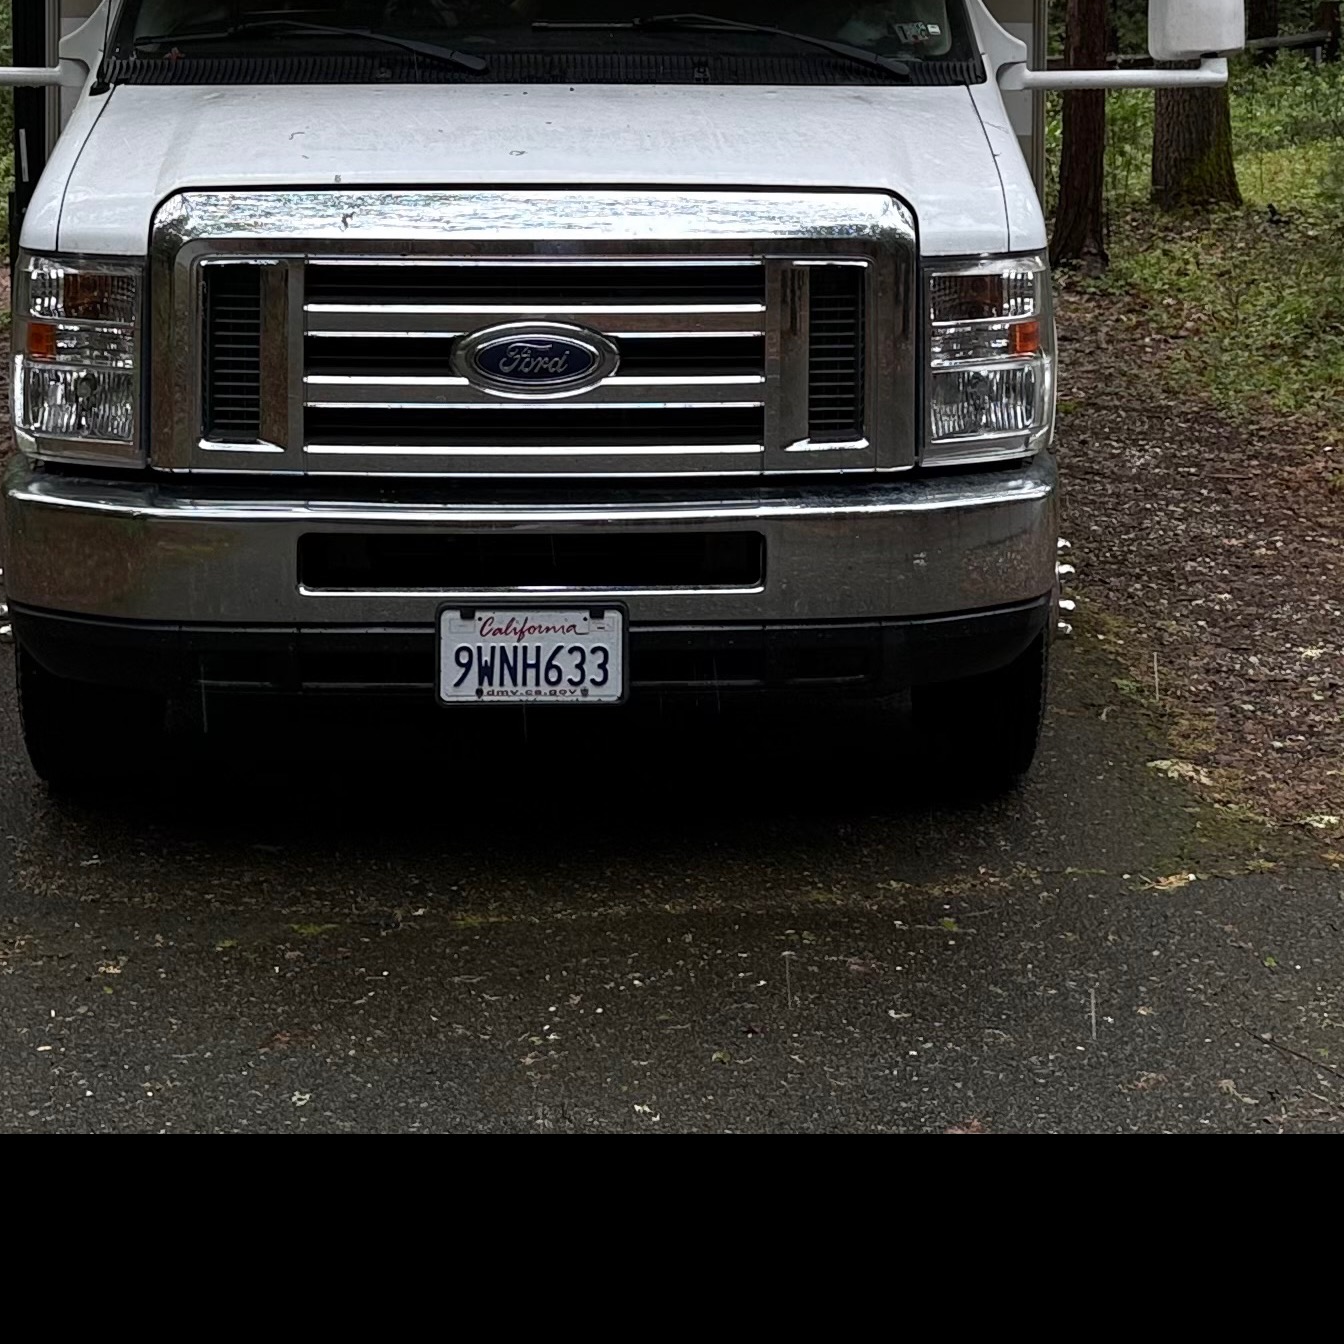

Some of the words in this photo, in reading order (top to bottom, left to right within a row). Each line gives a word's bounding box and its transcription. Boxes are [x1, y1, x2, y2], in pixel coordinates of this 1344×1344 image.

[498, 342, 571, 374] Ford
[479, 616, 590, 643] California
[453, 644, 610, 688] 9WNH633
[486, 688, 578, 697] dmv.ca.gov
